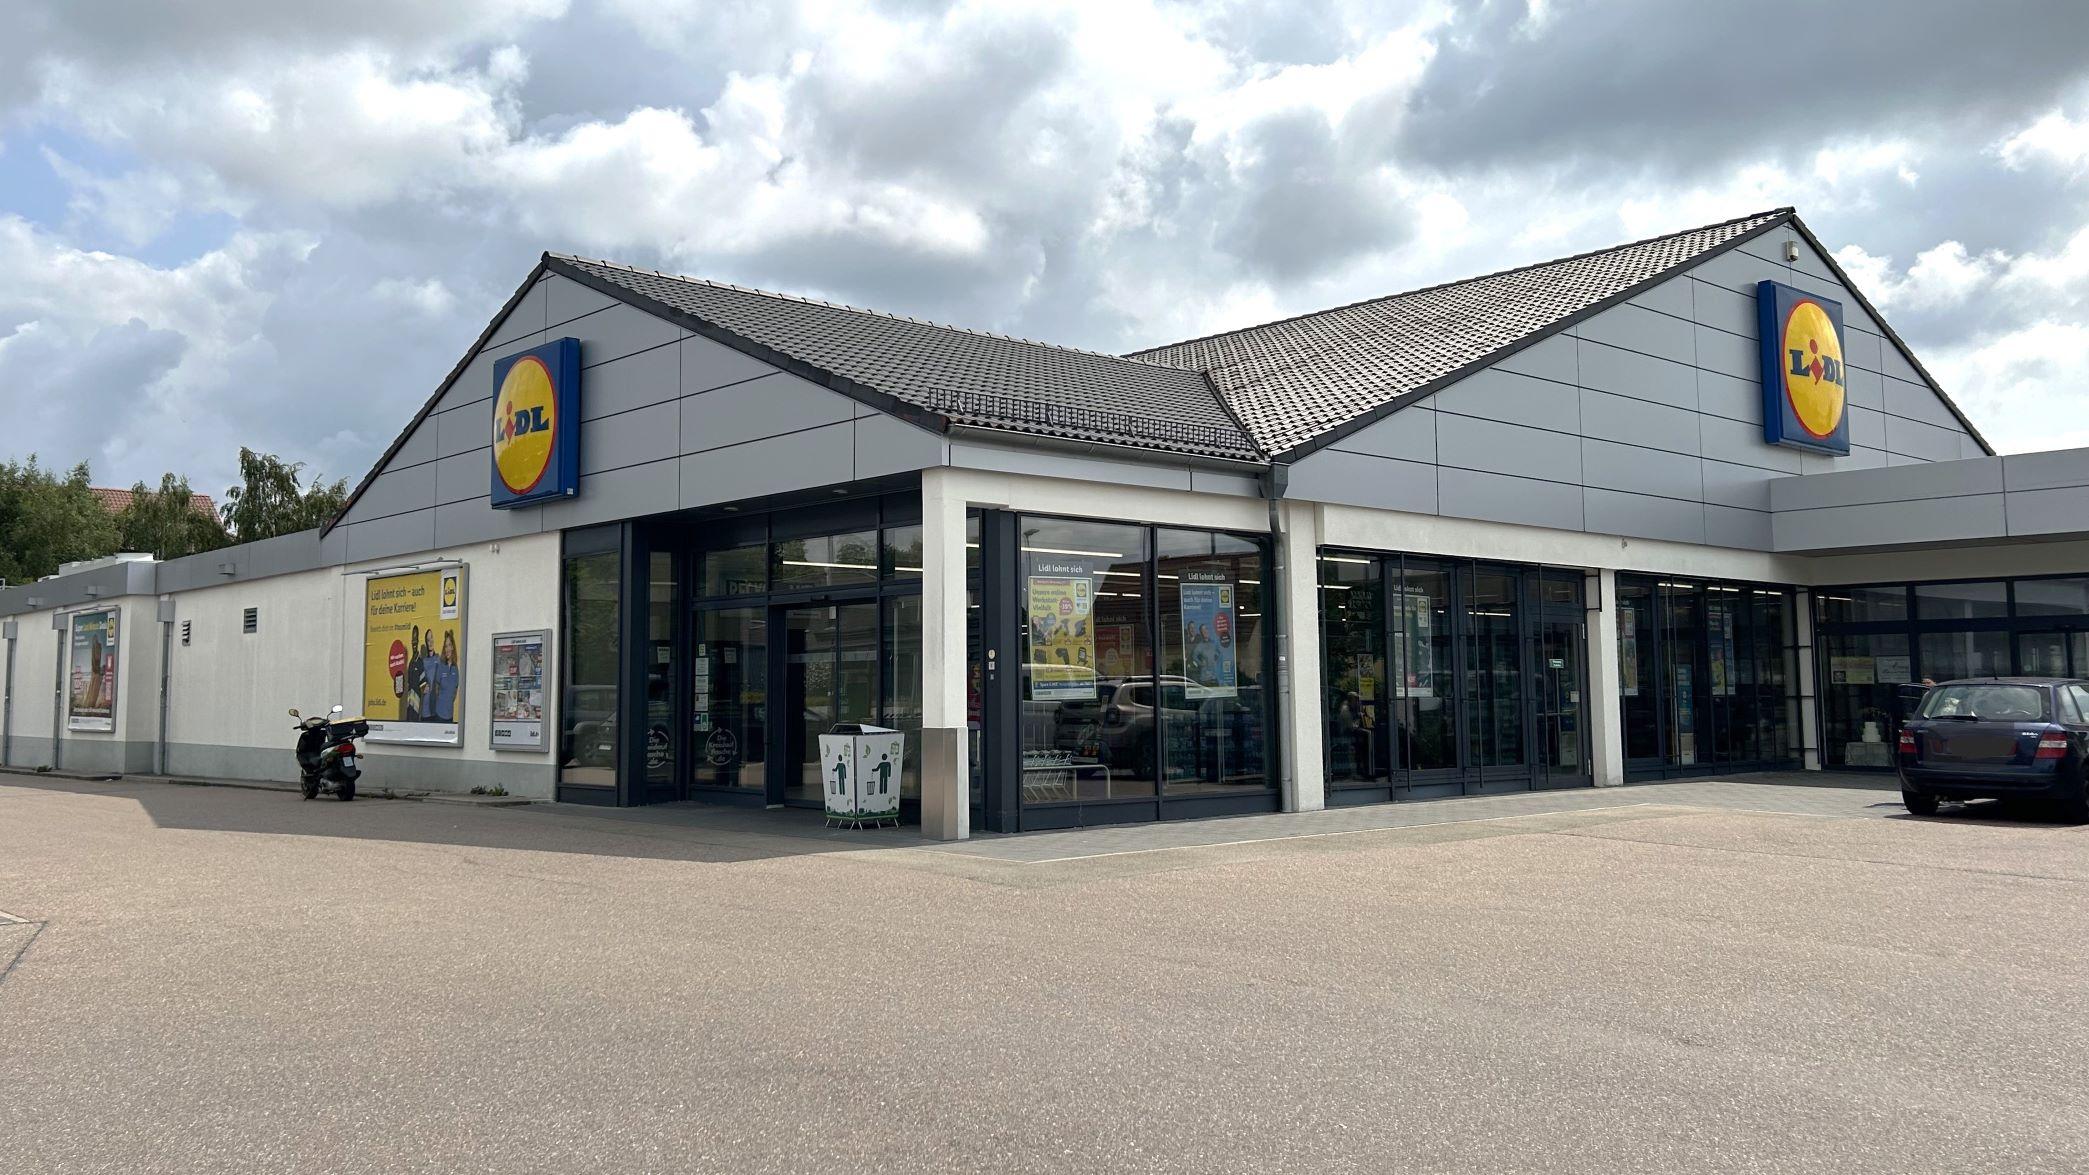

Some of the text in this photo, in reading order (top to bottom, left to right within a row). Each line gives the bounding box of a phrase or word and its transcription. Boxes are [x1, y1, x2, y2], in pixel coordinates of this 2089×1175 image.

[1789, 339, 1843, 385] LIDL
[495, 400, 549, 445] LIDL
[1038, 564, 1083, 573] Lidl lohnt sich
[1188, 572, 1225, 581] Lidl lohnt sich
[371, 589, 381, 600] Lidl
[381, 588, 395, 600] lohnt
[395, 586, 406, 598] sich
[411, 585, 425, 597] auch
[1032, 588, 1050, 596] Unsere
[378, 603, 393, 615] deine
[394, 602, 416, 613] Karriere!
